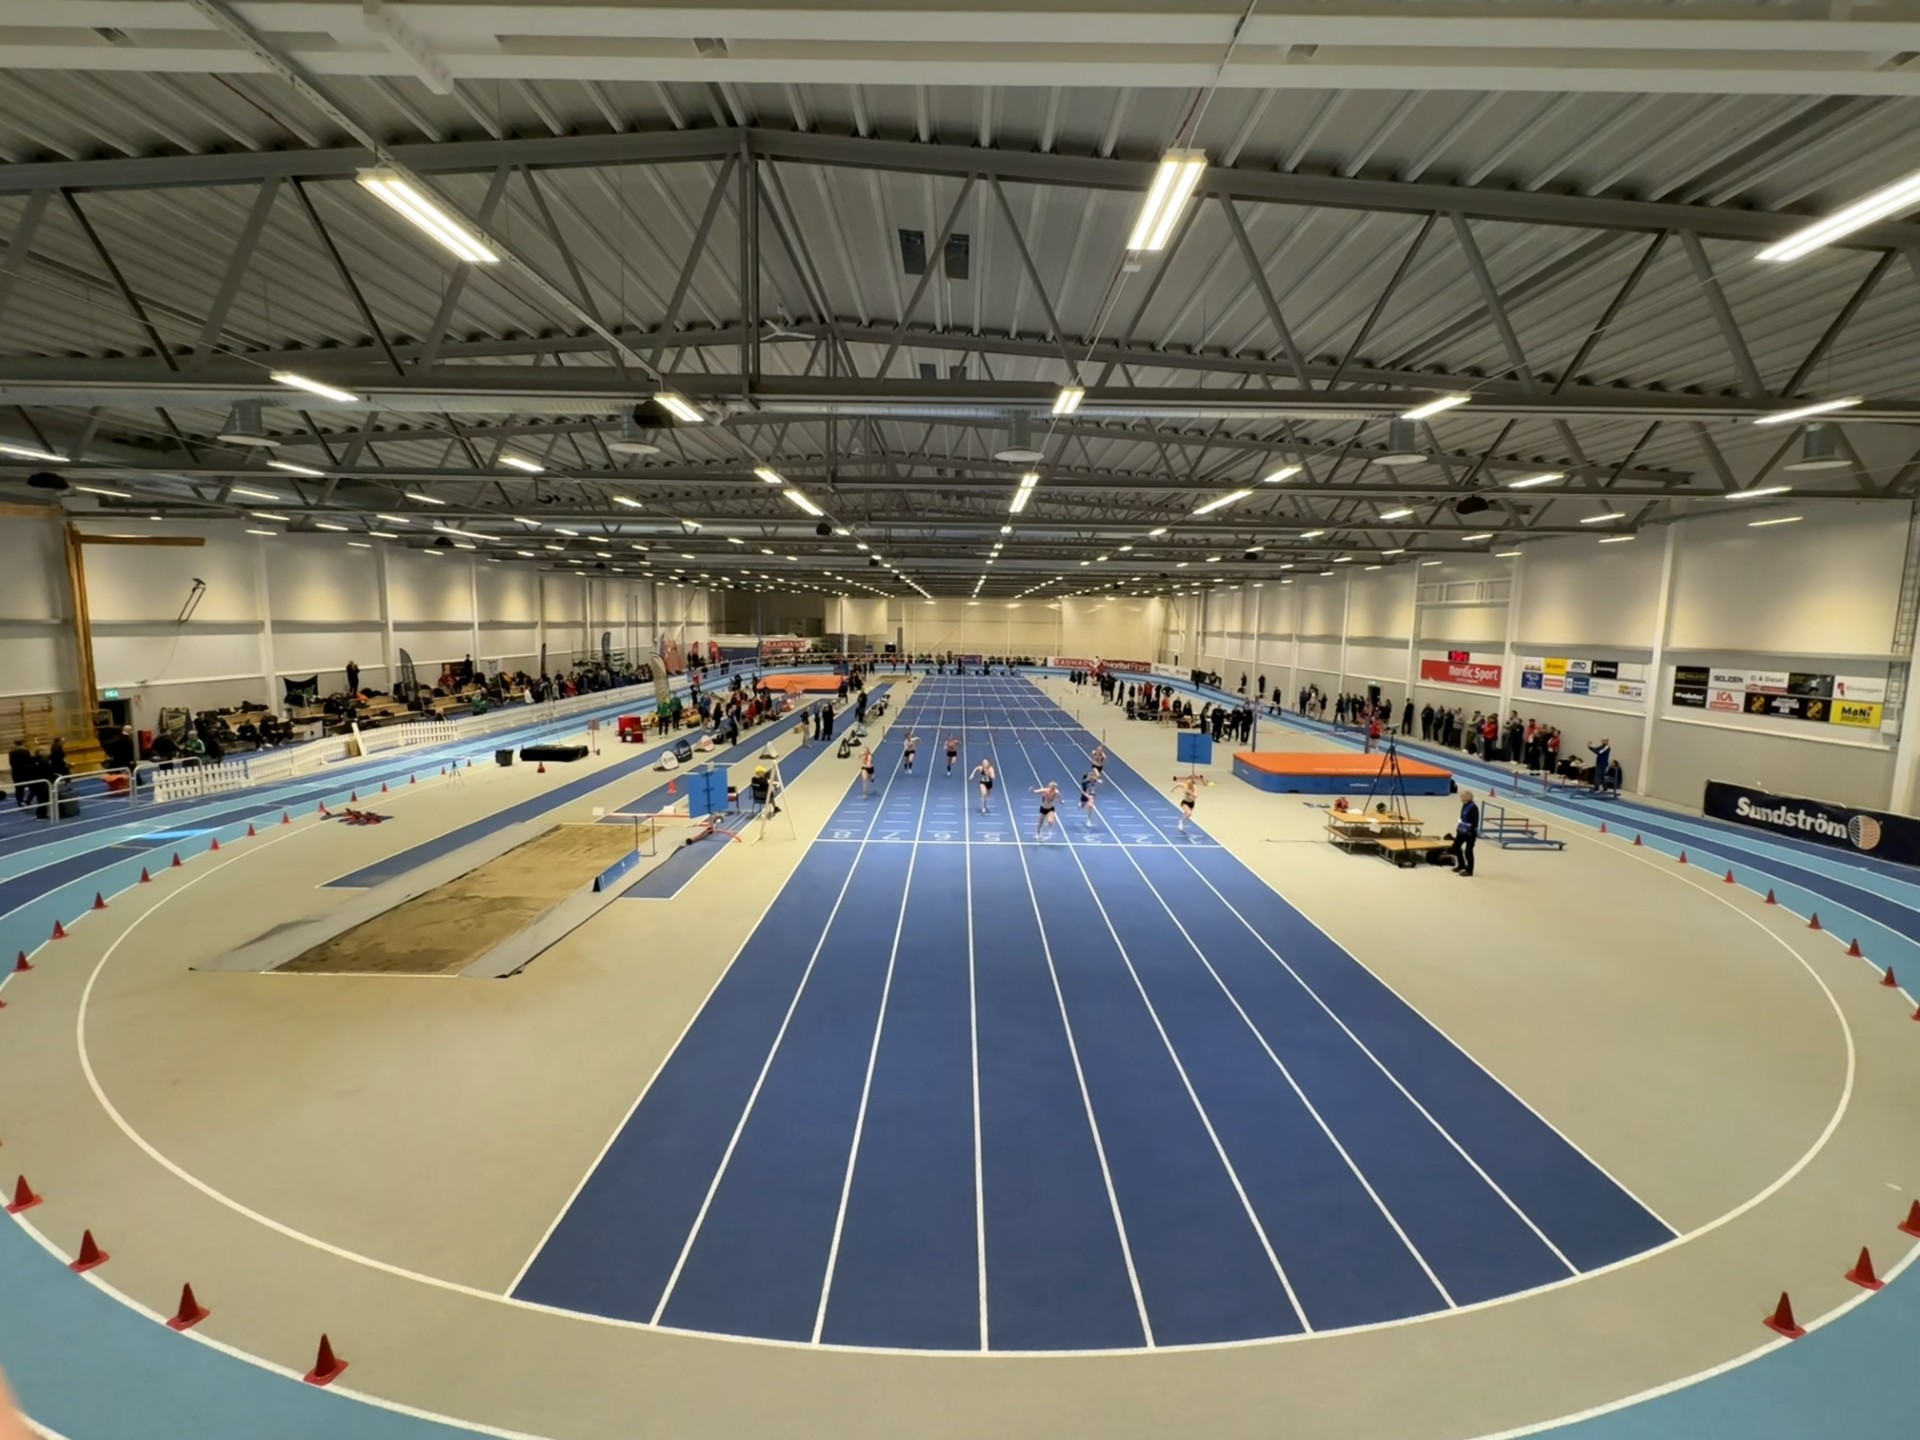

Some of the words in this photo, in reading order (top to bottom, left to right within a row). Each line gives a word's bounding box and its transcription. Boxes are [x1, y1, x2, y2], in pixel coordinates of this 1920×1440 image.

[1448, 665, 1474, 678] Nordic
[1474, 667, 1498, 681] Sport
[1764, 675, 1785, 683] Diesel
[1716, 691, 1733, 702] ICA
[1841, 705, 1873, 718] MaNi
[1735, 796, 1848, 840] Sundström
[833, 831, 852, 840] 8
[882, 831, 901, 841] 7
[984, 832, 1001, 842] 5
